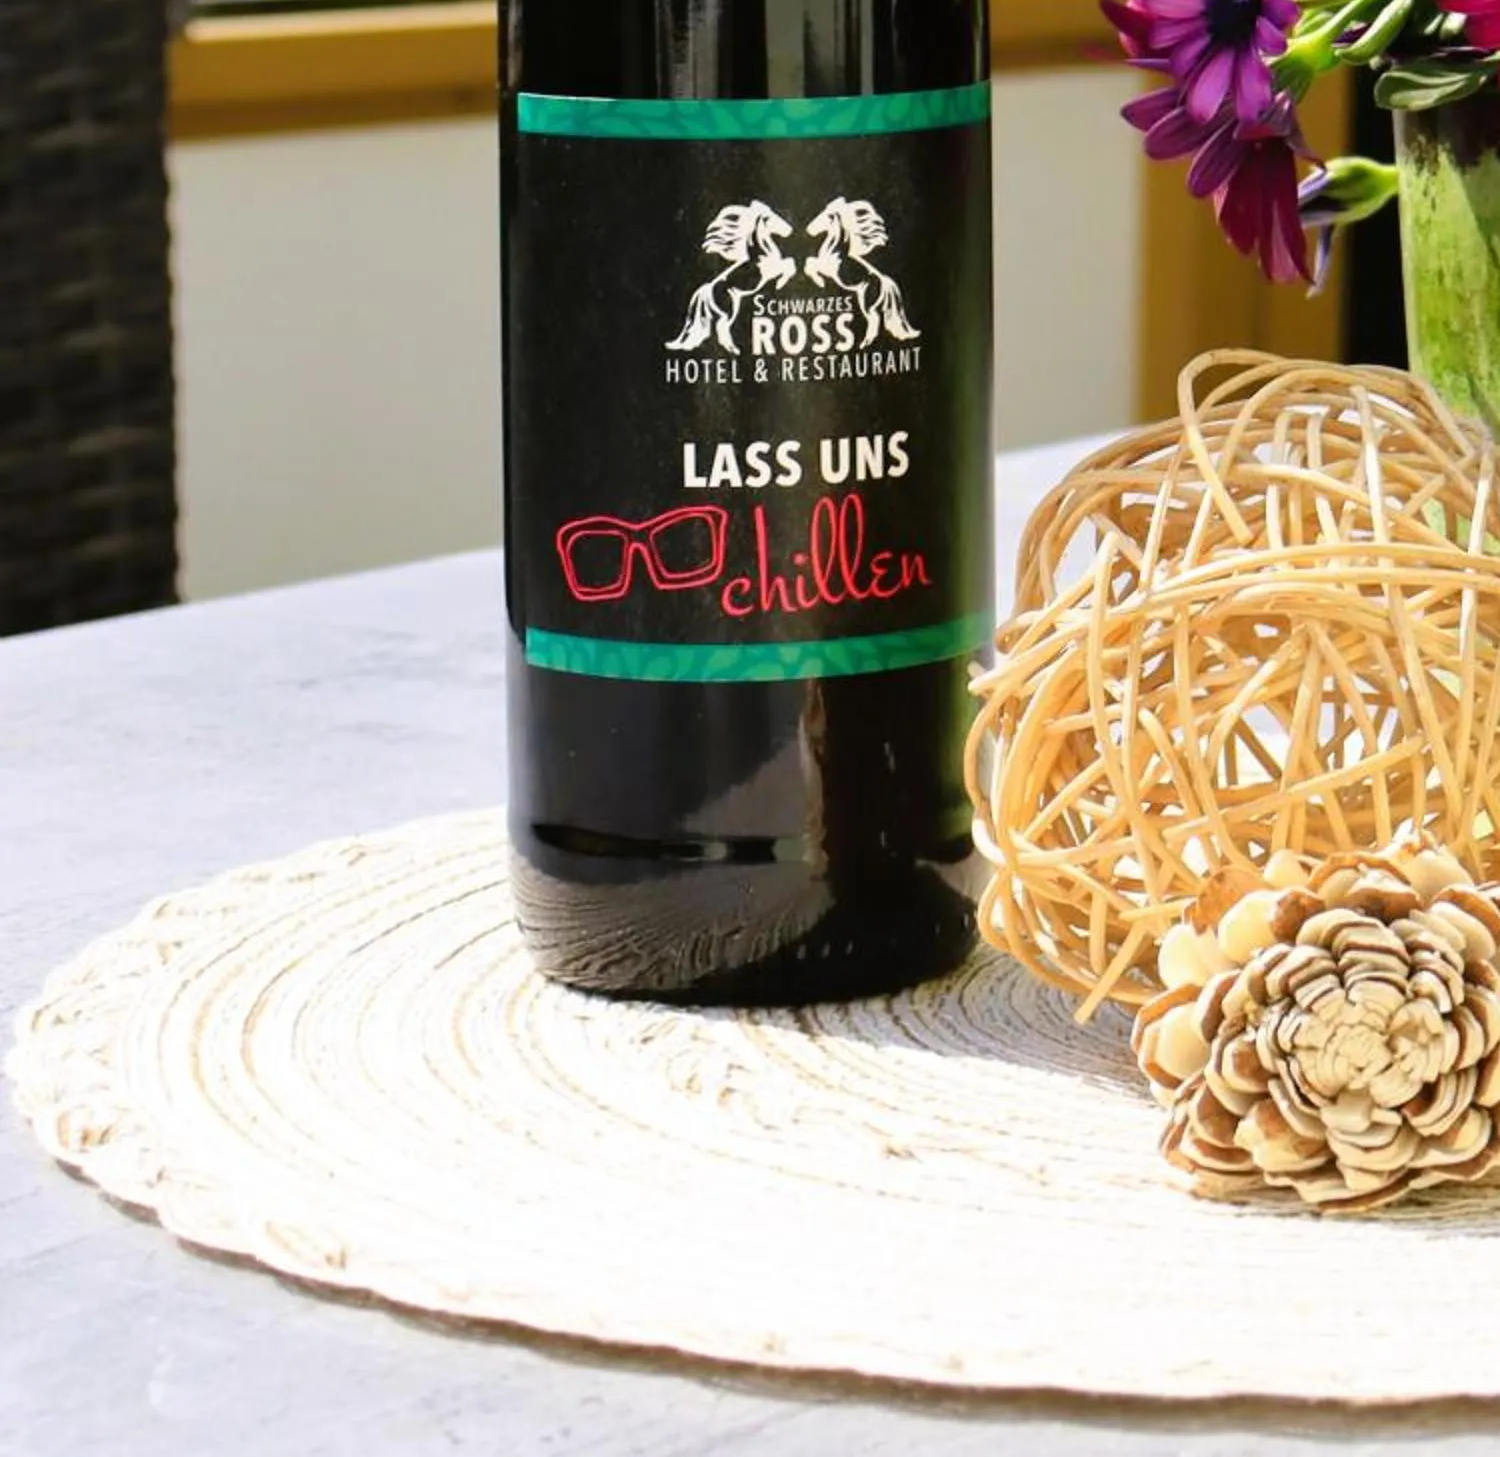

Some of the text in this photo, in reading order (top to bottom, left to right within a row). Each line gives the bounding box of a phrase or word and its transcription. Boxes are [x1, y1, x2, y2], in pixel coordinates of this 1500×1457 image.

[752, 312, 855, 355] ROSS
[665, 346, 922, 384] HOTEL & RESTAURANT
[682, 431, 910, 488] LASS UNS
[720, 494, 931, 617] chillen
